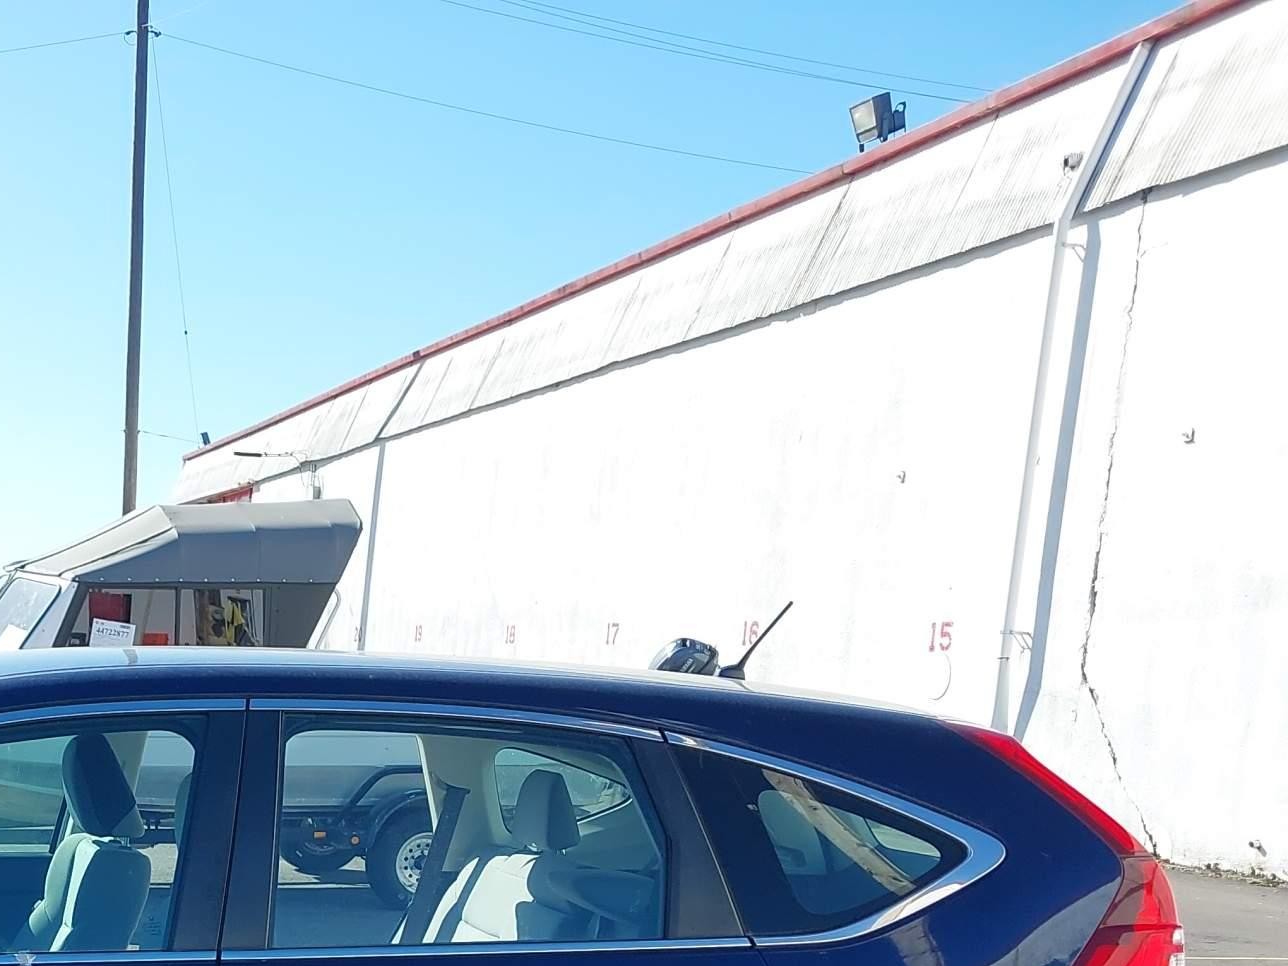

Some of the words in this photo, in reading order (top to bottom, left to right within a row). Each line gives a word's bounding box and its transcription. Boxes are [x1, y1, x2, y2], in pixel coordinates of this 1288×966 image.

[414, 624, 423, 642] 19
[505, 624, 516, 644] 18
[605, 622, 620, 645] 17
[741, 620, 760, 646] 16
[928, 621, 954, 652] 15
